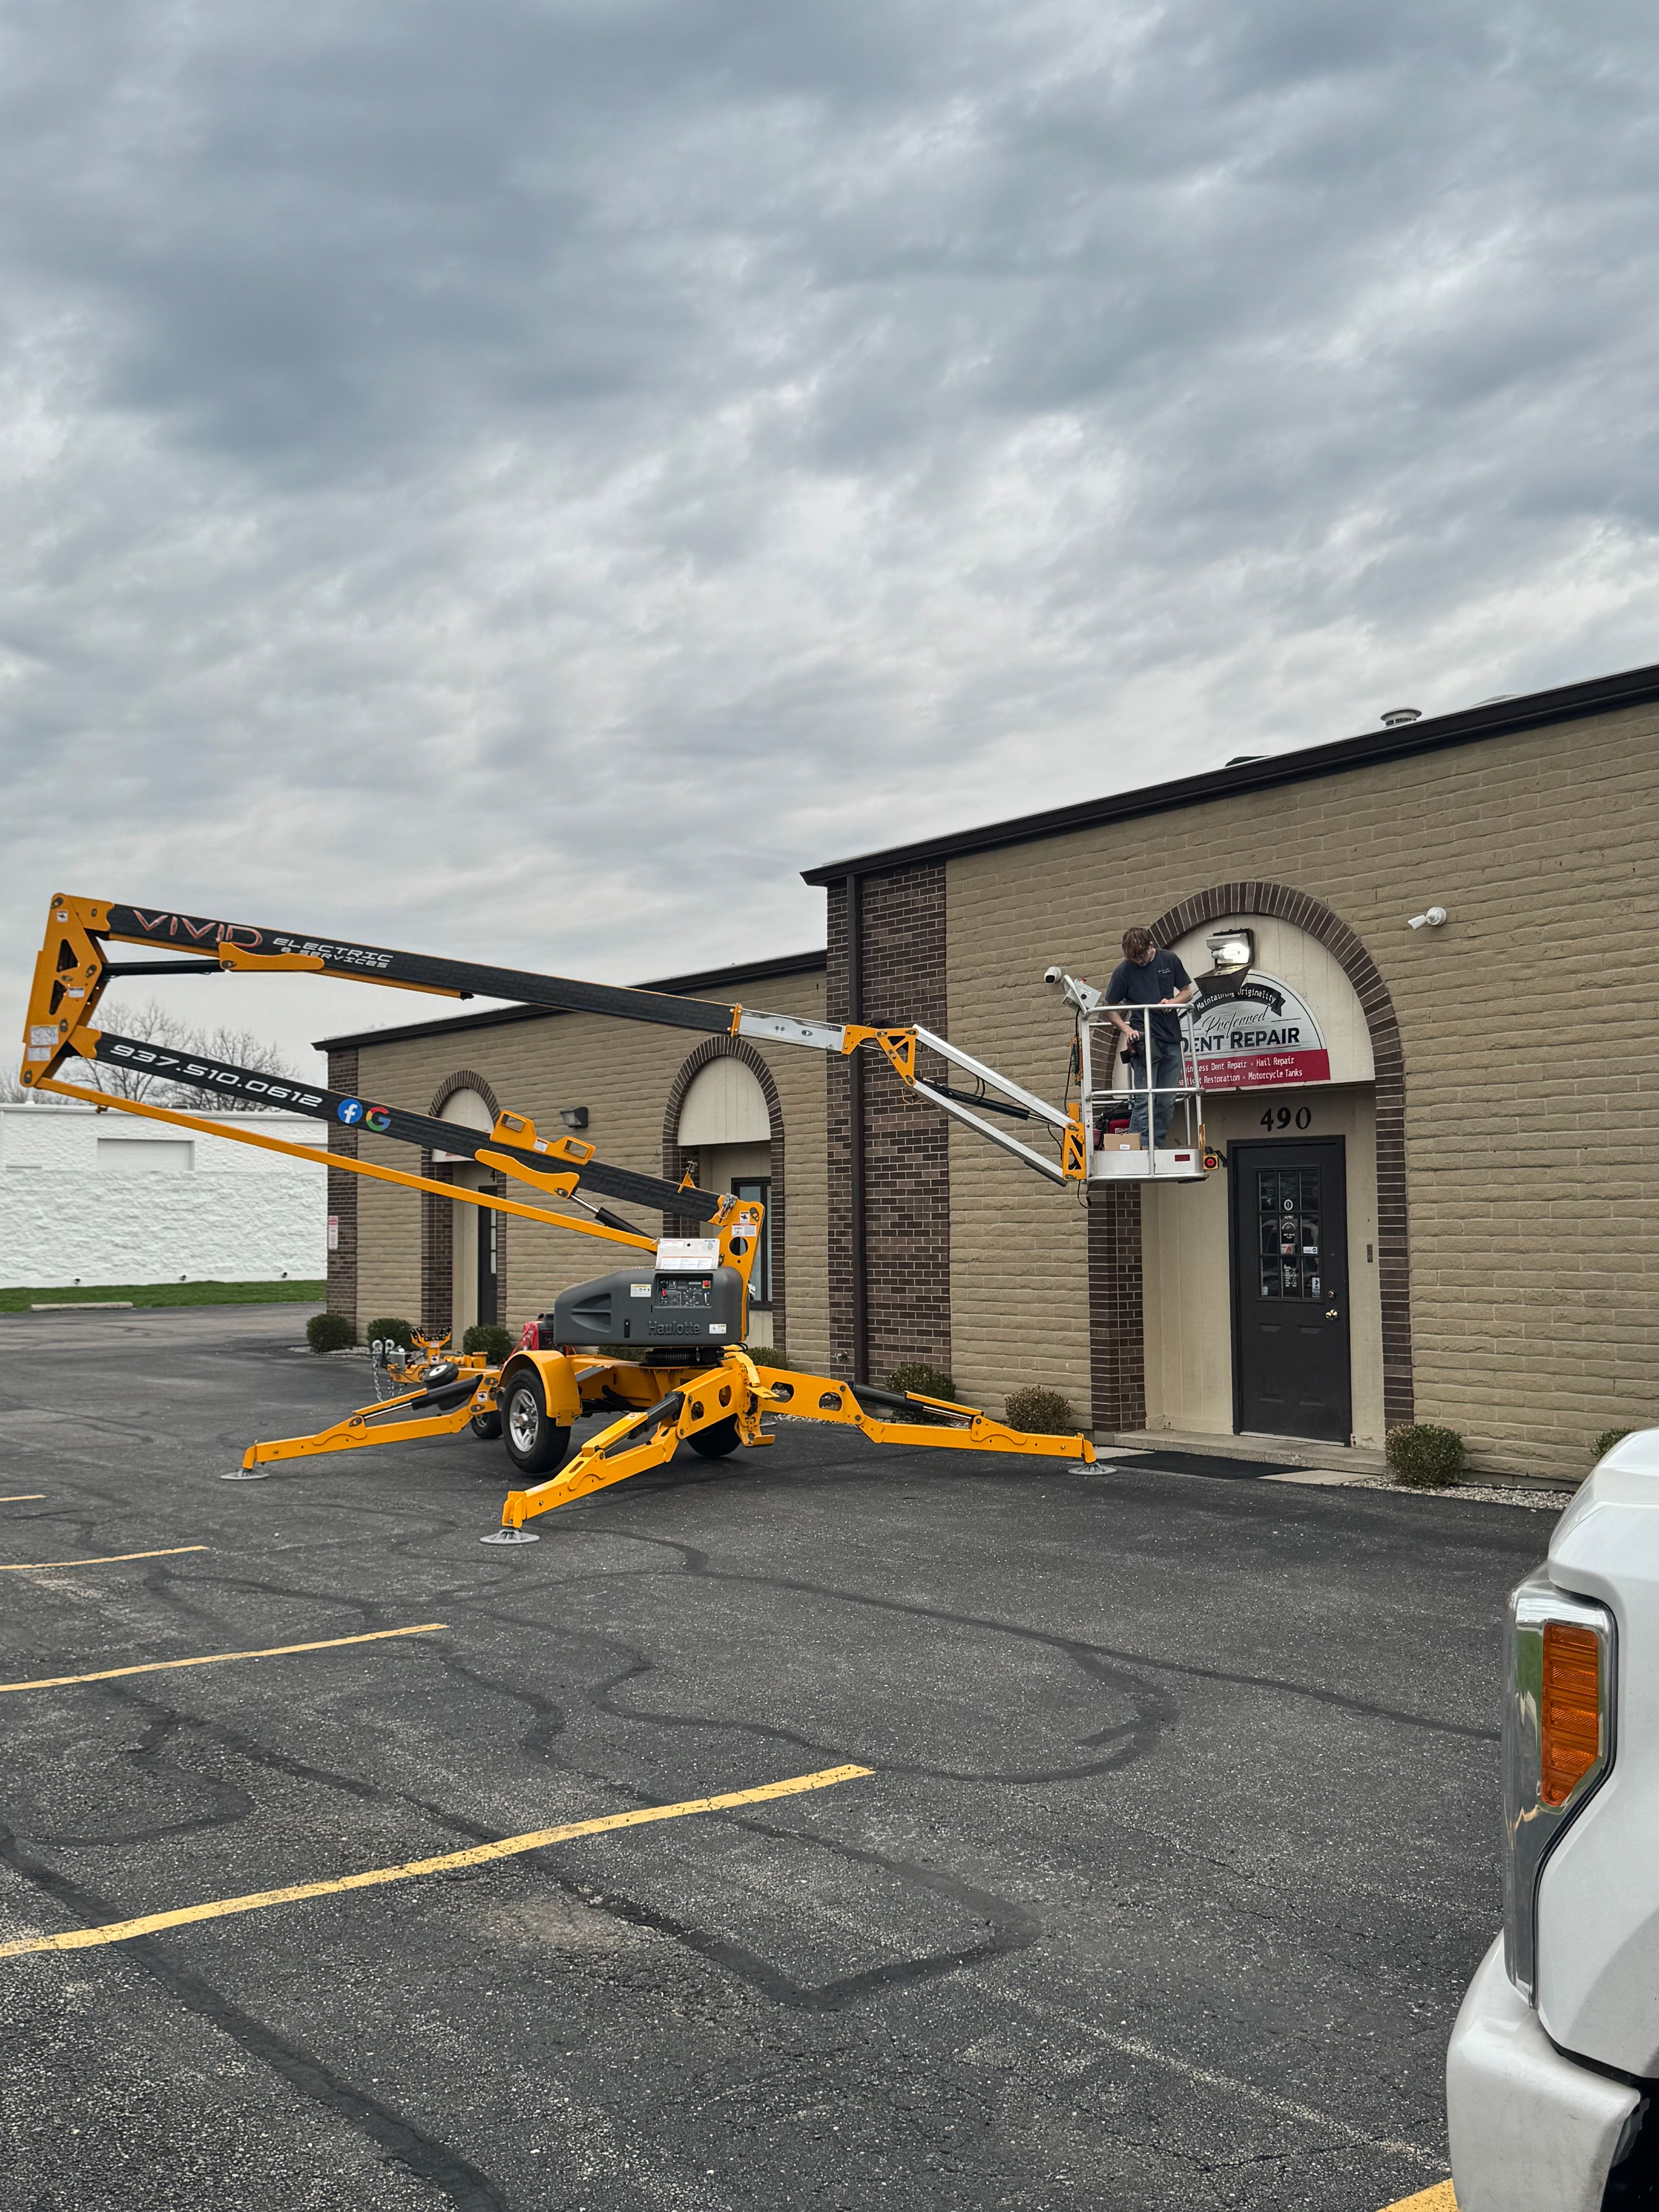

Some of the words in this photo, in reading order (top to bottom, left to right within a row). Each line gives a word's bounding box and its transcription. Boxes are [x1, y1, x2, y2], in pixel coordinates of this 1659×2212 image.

[133, 910, 263, 948] VIVID
[273, 938, 393, 962] ELECTRIC
[299, 950, 388, 968] SERVICES
[1202, 1004, 1271, 1039] Preferred
[1230, 1027, 1300, 1049] REPAIR
[1211, 1063, 1224, 1071] Dent
[1227, 1060, 1247, 1070] Repair
[1256, 1058, 1271, 1067] Hail
[1273, 1056, 1295, 1067] Repair
[110, 1044, 323, 1108] 937.510.0612
[1204, 1074, 1240, 1084] Restoration
[1248, 1069, 1283, 1080] Motorcycle
[1285, 1068, 1303, 1078] Tanks
[1260, 1106, 1312, 1132] 490
[648, 1321, 701, 1336] Haulotte
